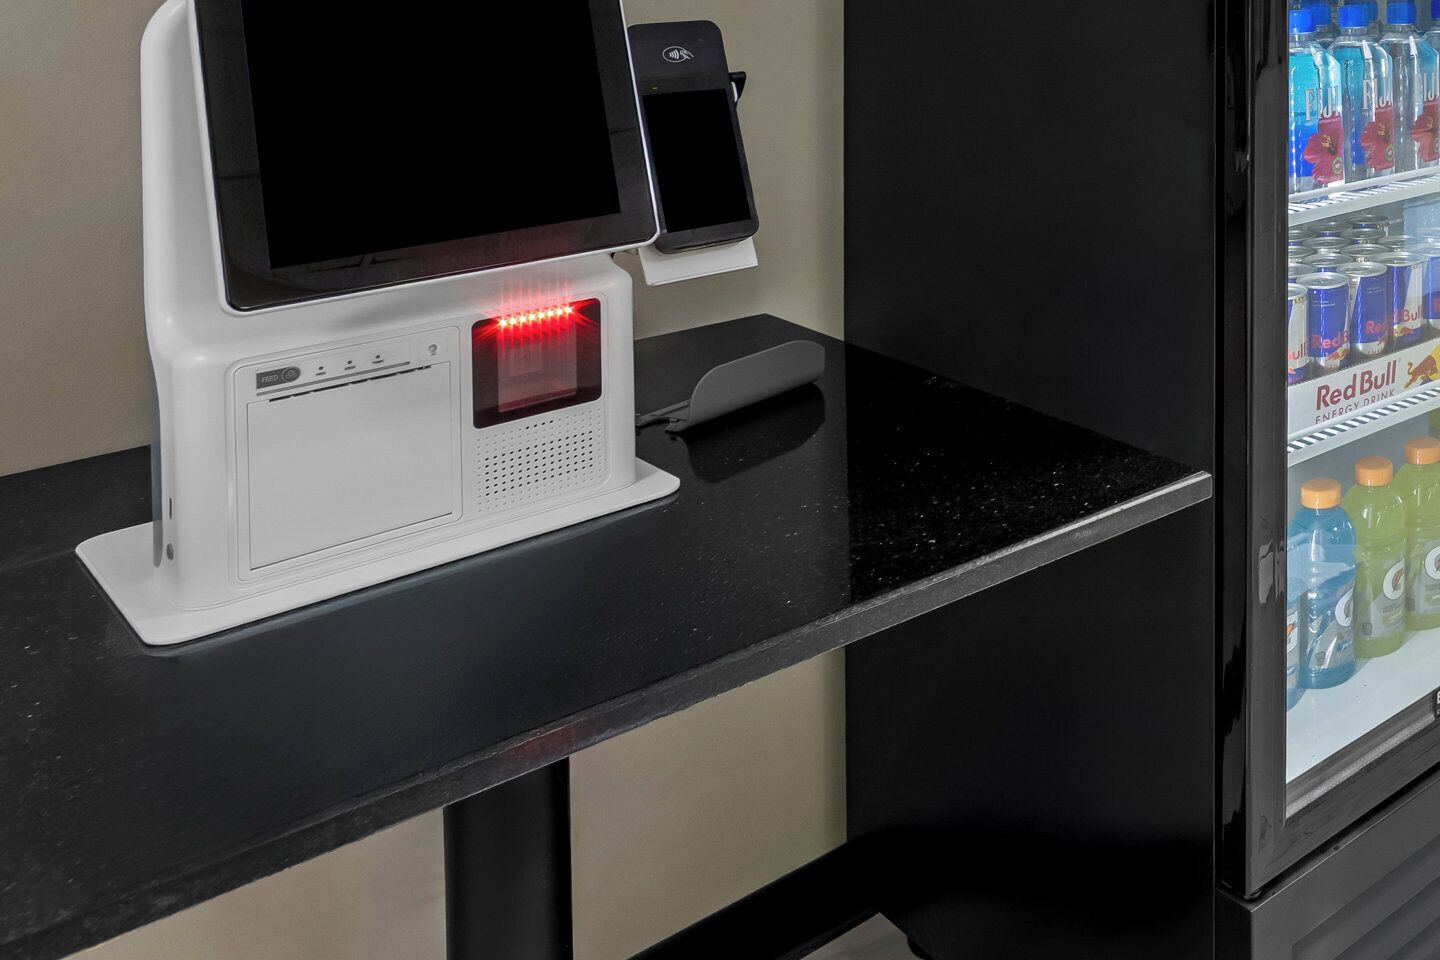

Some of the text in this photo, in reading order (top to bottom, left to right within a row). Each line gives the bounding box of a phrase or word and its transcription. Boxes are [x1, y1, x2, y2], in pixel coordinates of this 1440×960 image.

[1304, 86, 1341, 121] FIJI
[1362, 79, 1393, 110] FIJI
[261, 374, 279, 383] FEED
[1317, 360, 1397, 411] Red Bull
[1316, 388, 1395, 424] ENERGY DRINK
